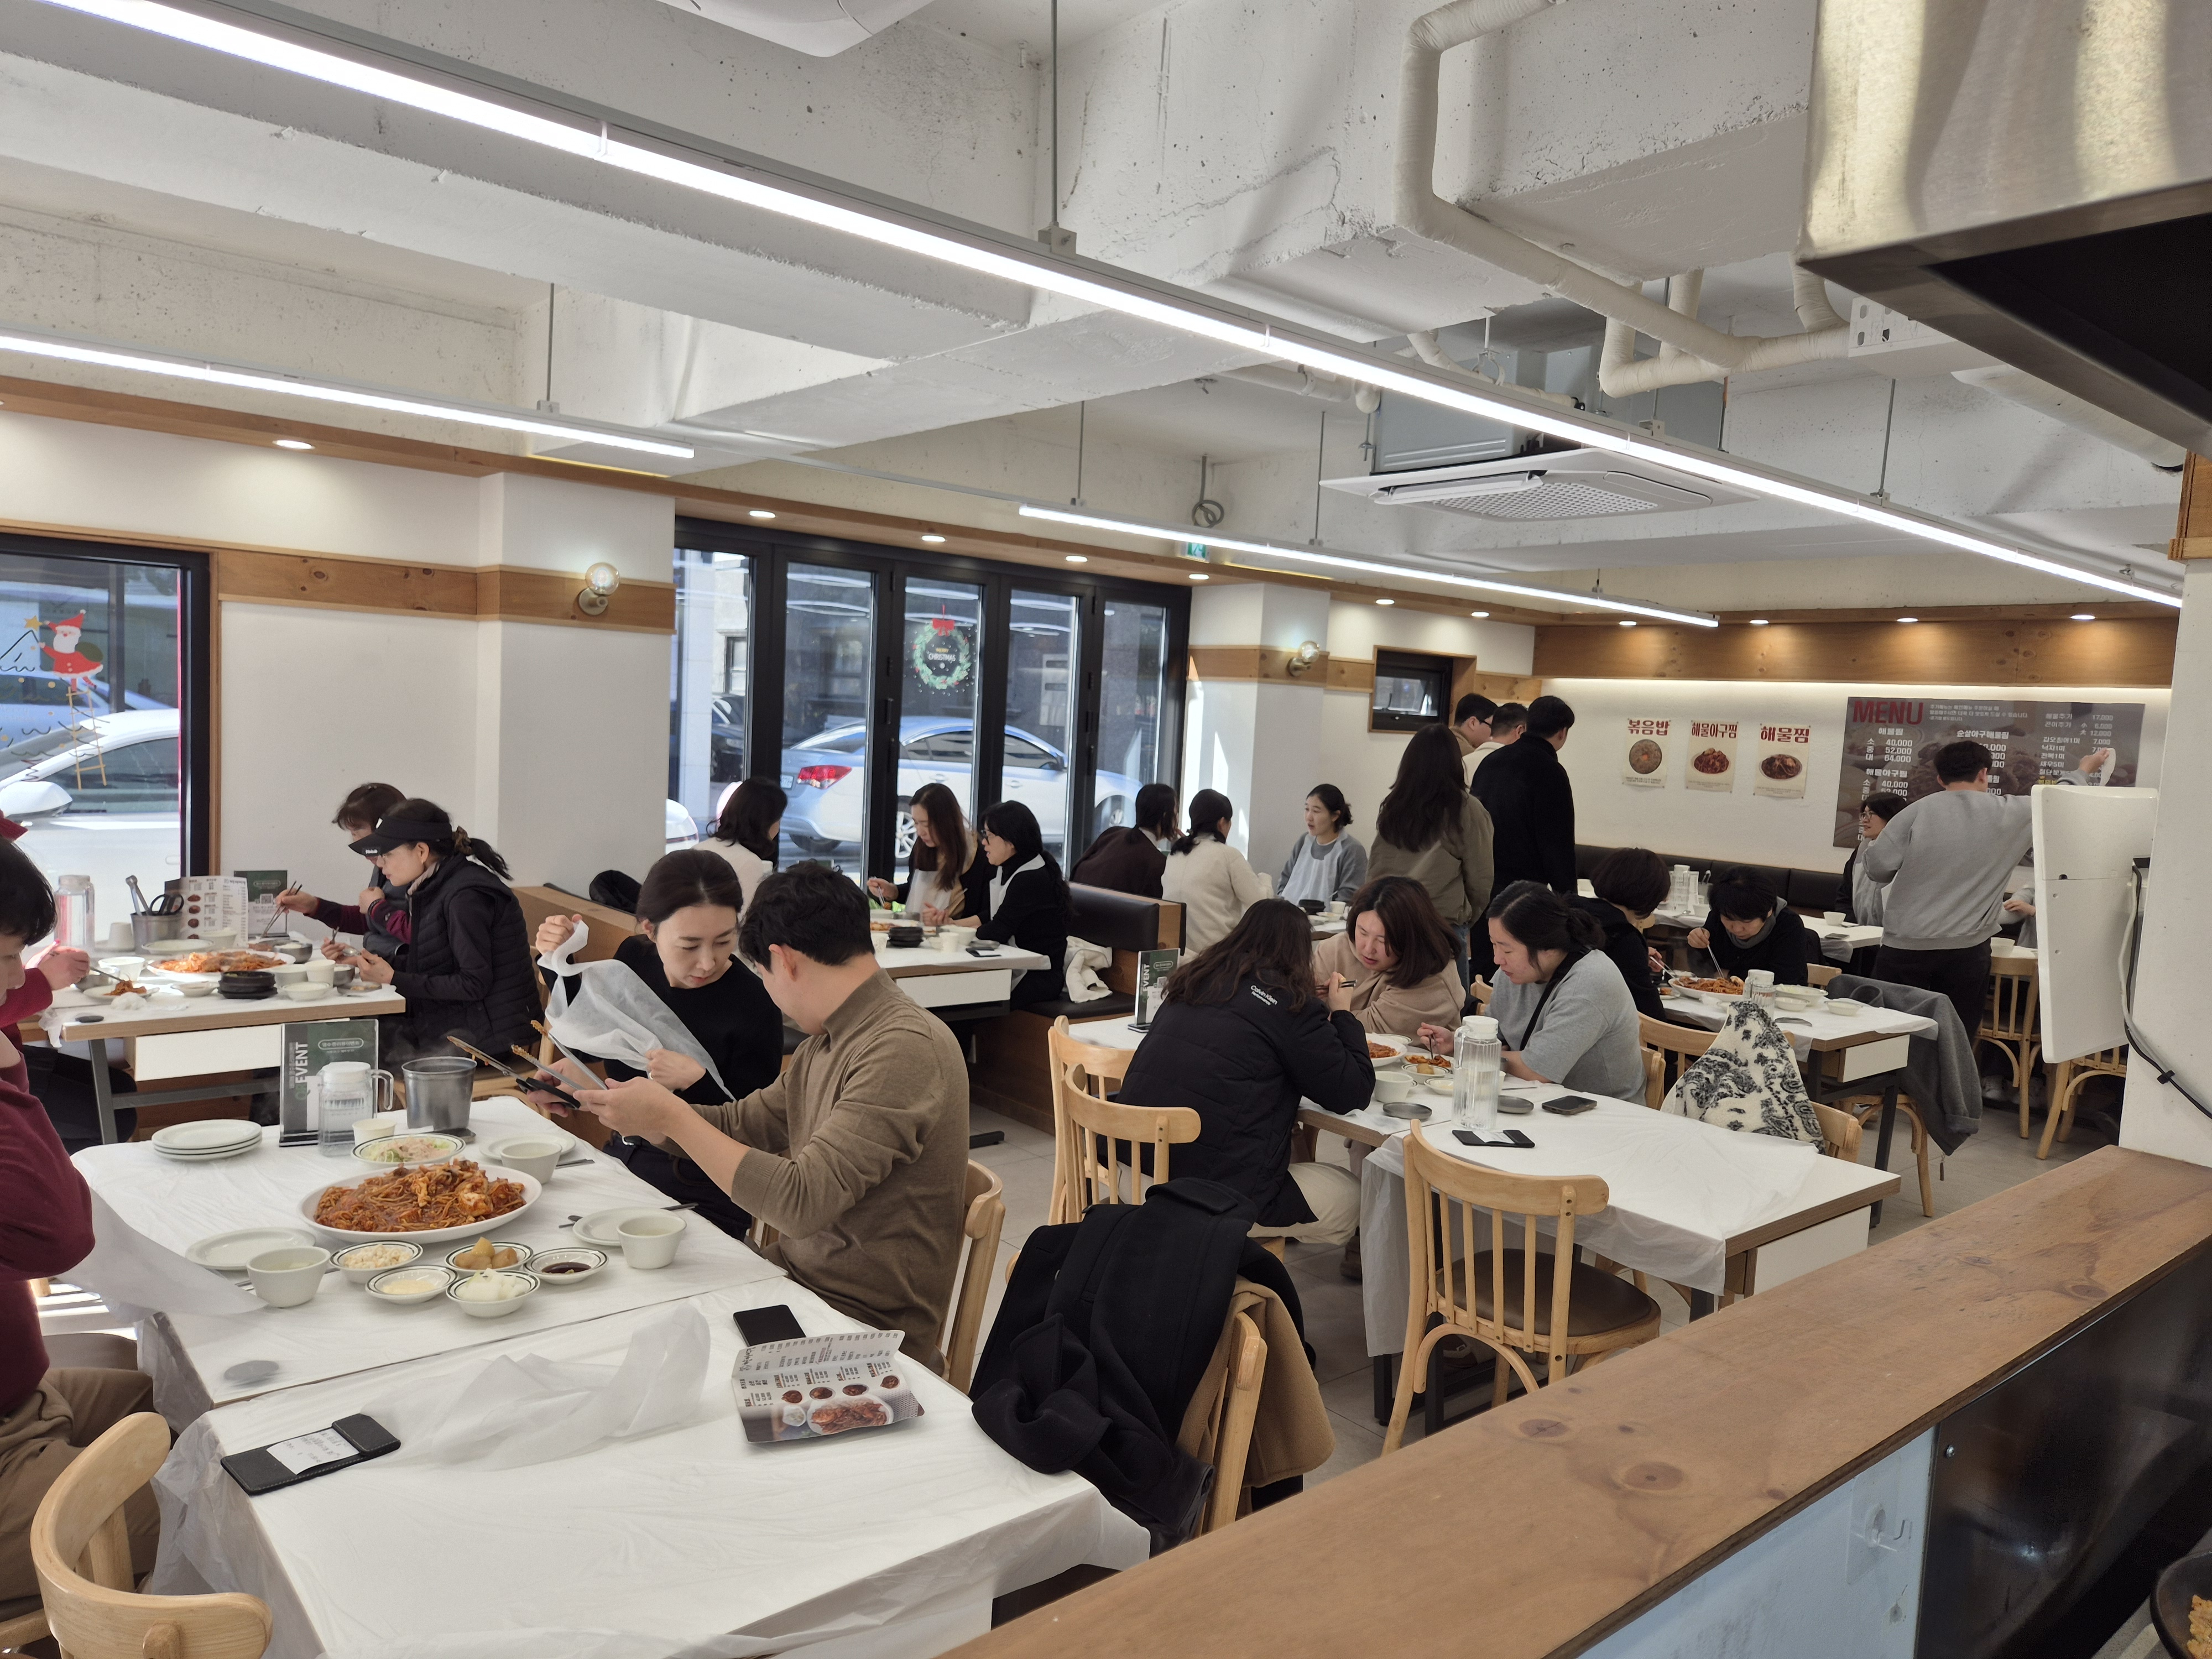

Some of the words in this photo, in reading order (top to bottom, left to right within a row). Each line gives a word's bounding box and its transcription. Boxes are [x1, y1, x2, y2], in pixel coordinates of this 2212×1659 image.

[927, 653, 956, 662] CHRISTMAS
[1853, 700, 1924, 725] MENU
[1627, 719, 1670, 736] 볶음밥
[1692, 722, 1738, 739] 해물아구찜
[1760, 726, 1809, 743] 해물찜
[1250, 985, 1266, 997] Calvin
[1265, 994, 1277, 1005] Klein
[295, 1041, 309, 1083] EVENT
